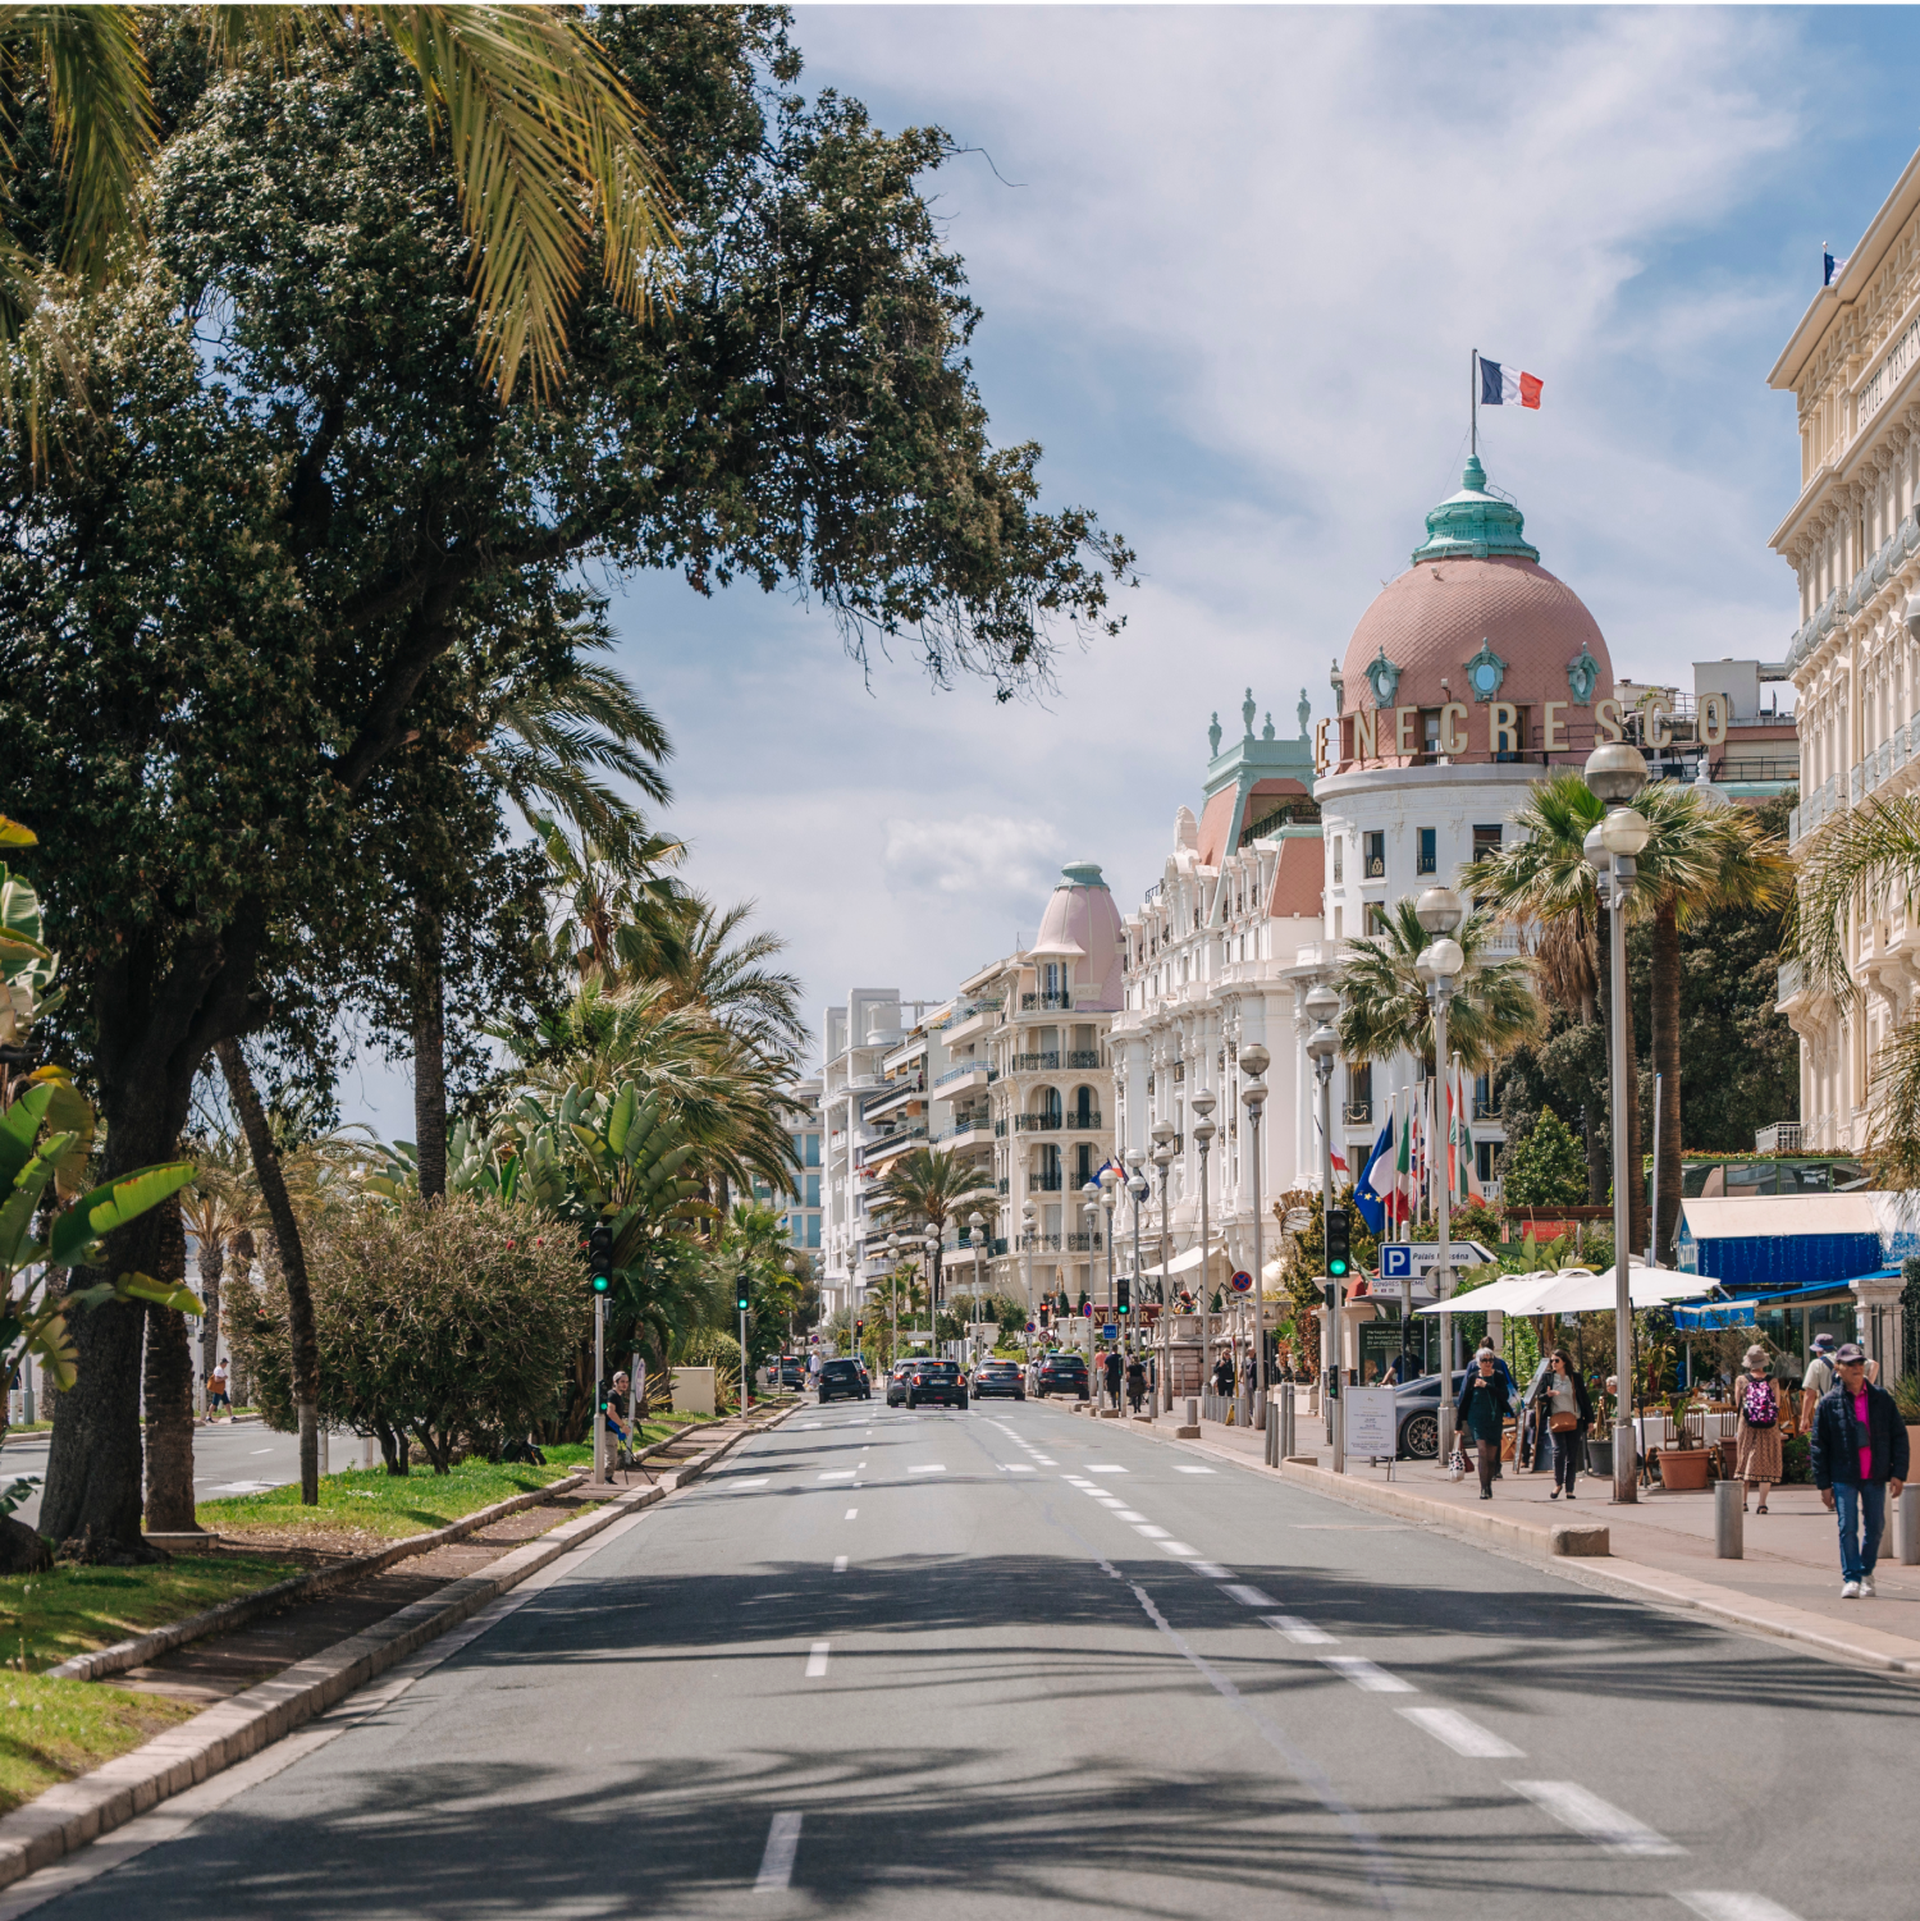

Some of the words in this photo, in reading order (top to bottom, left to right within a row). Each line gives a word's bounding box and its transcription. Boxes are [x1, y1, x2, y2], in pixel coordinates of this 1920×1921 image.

[1353, 692, 1728, 760] NEGRESCO
[1388, 1250, 1406, 1274] P
[1412, 1252, 1435, 1260] Palais
